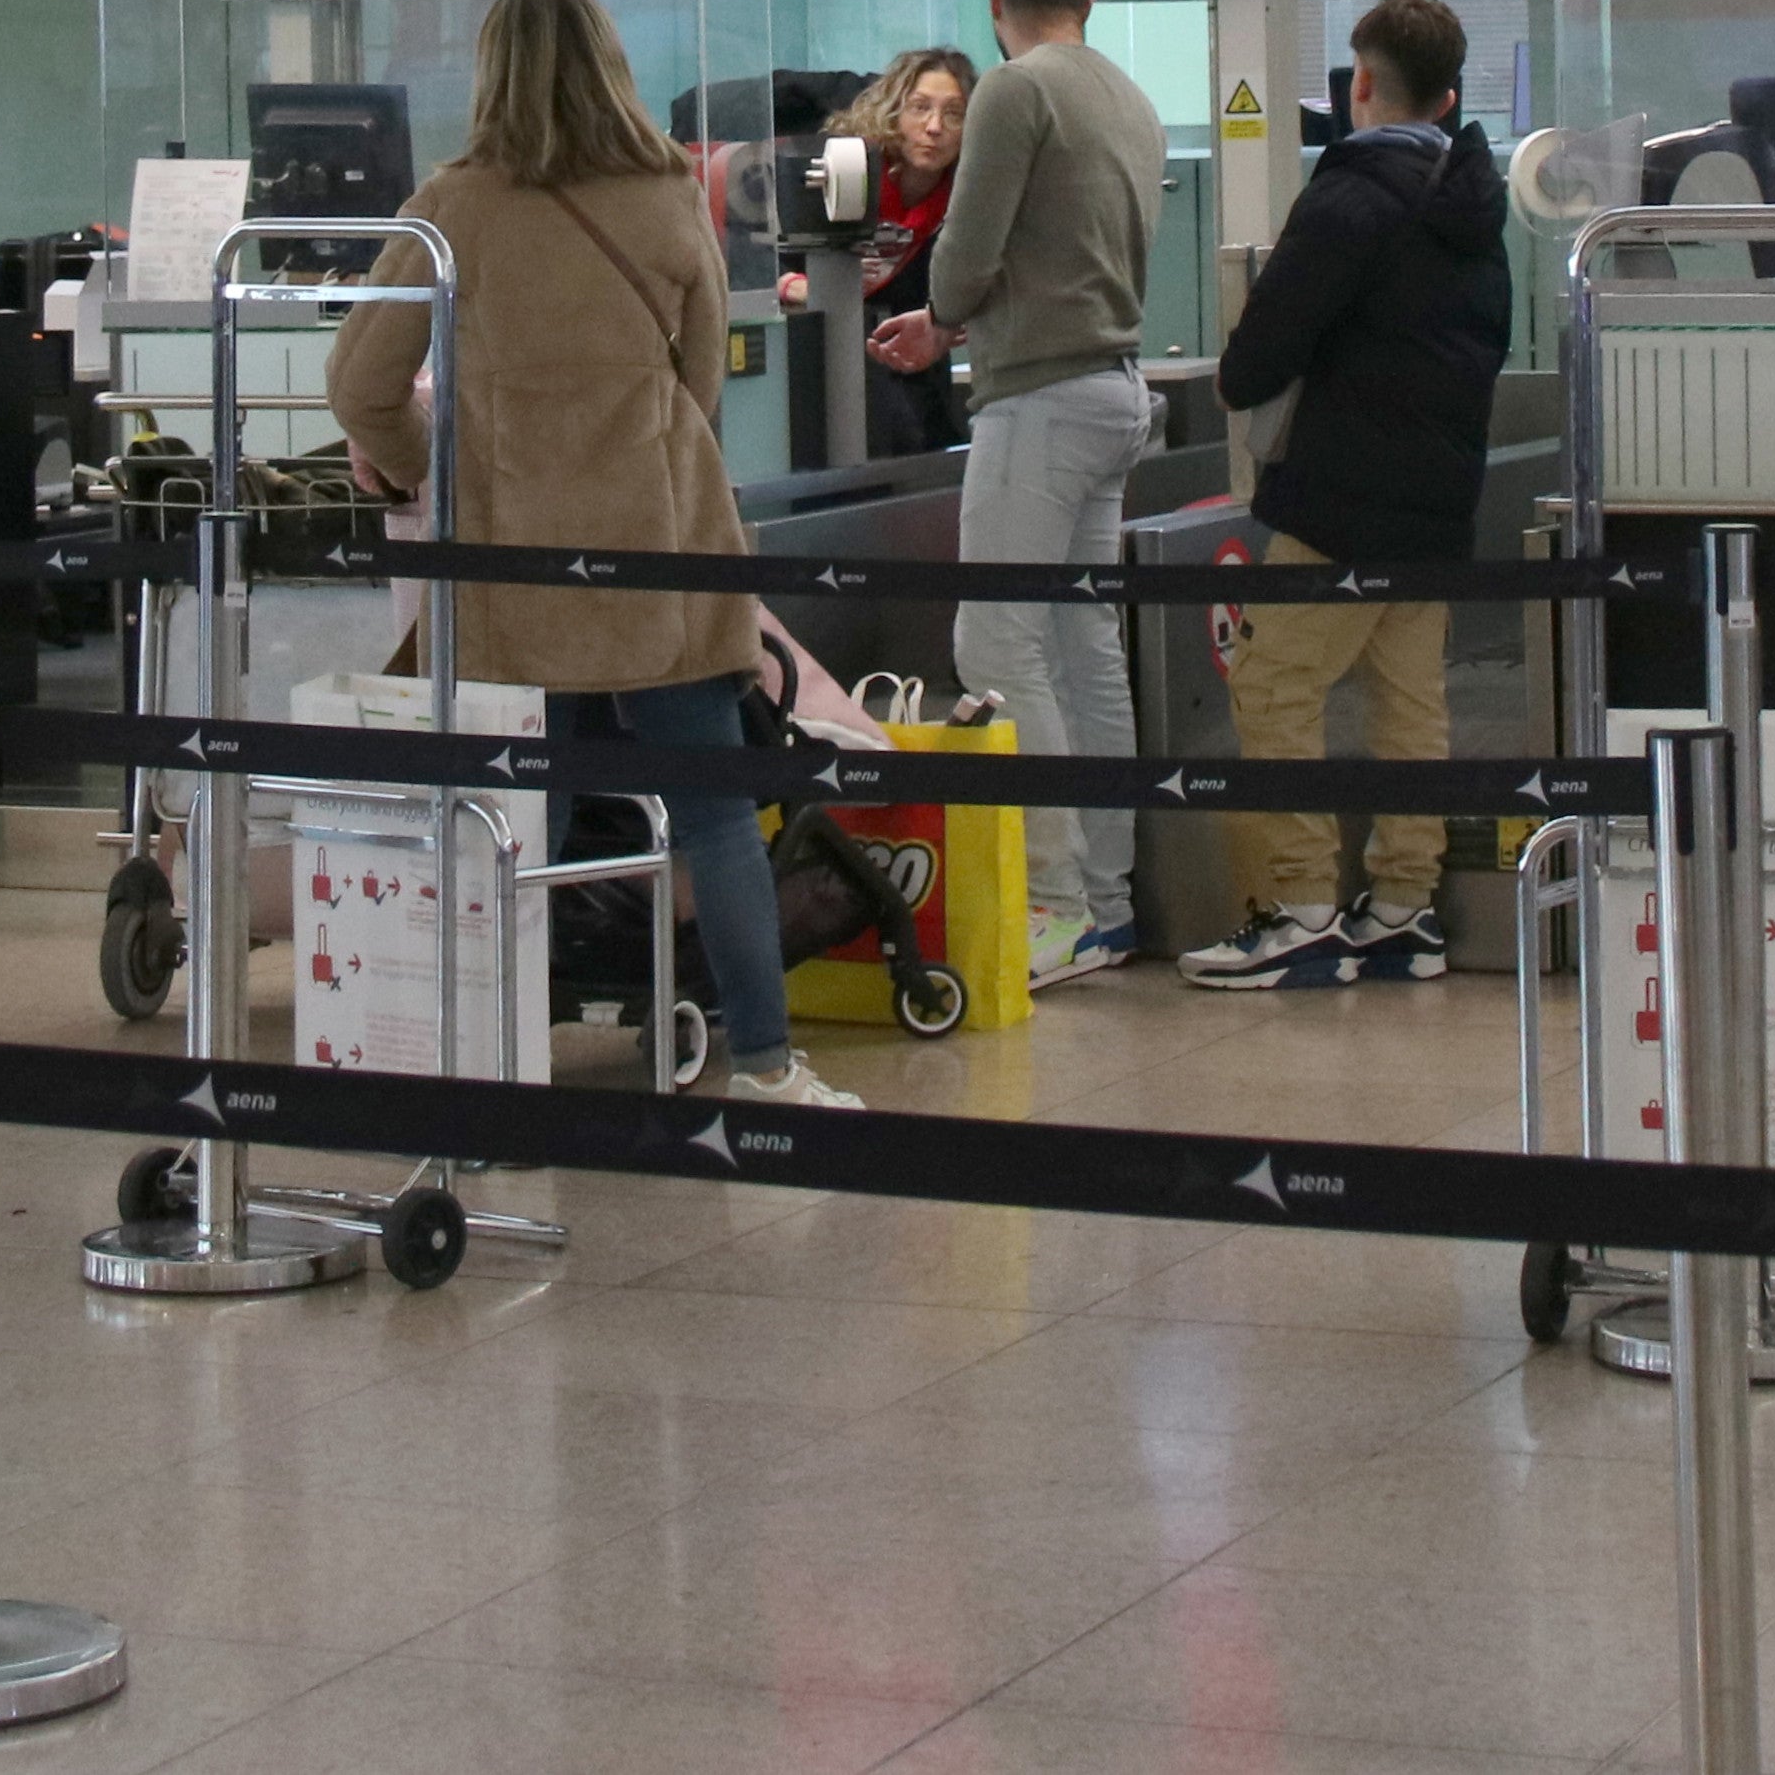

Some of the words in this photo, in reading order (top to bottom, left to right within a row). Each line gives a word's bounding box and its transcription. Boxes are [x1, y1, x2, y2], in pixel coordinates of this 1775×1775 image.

[347, 551, 374, 562] aena
[589, 563, 616, 574] aena
[839, 573, 867, 584] aena
[1634, 571, 1664, 581] aena
[1096, 579, 1125, 589] aena
[1361, 578, 1390, 588] aena
[207, 740, 240, 753] aena
[516, 757, 550, 770] aena
[843, 770, 880, 782] aena
[1188, 778, 1227, 791] aena
[1550, 780, 1589, 794] aena
[225, 1092, 277, 1111] aena
[738, 1131, 794, 1153] aena
[1286, 1173, 1345, 1195] aena
